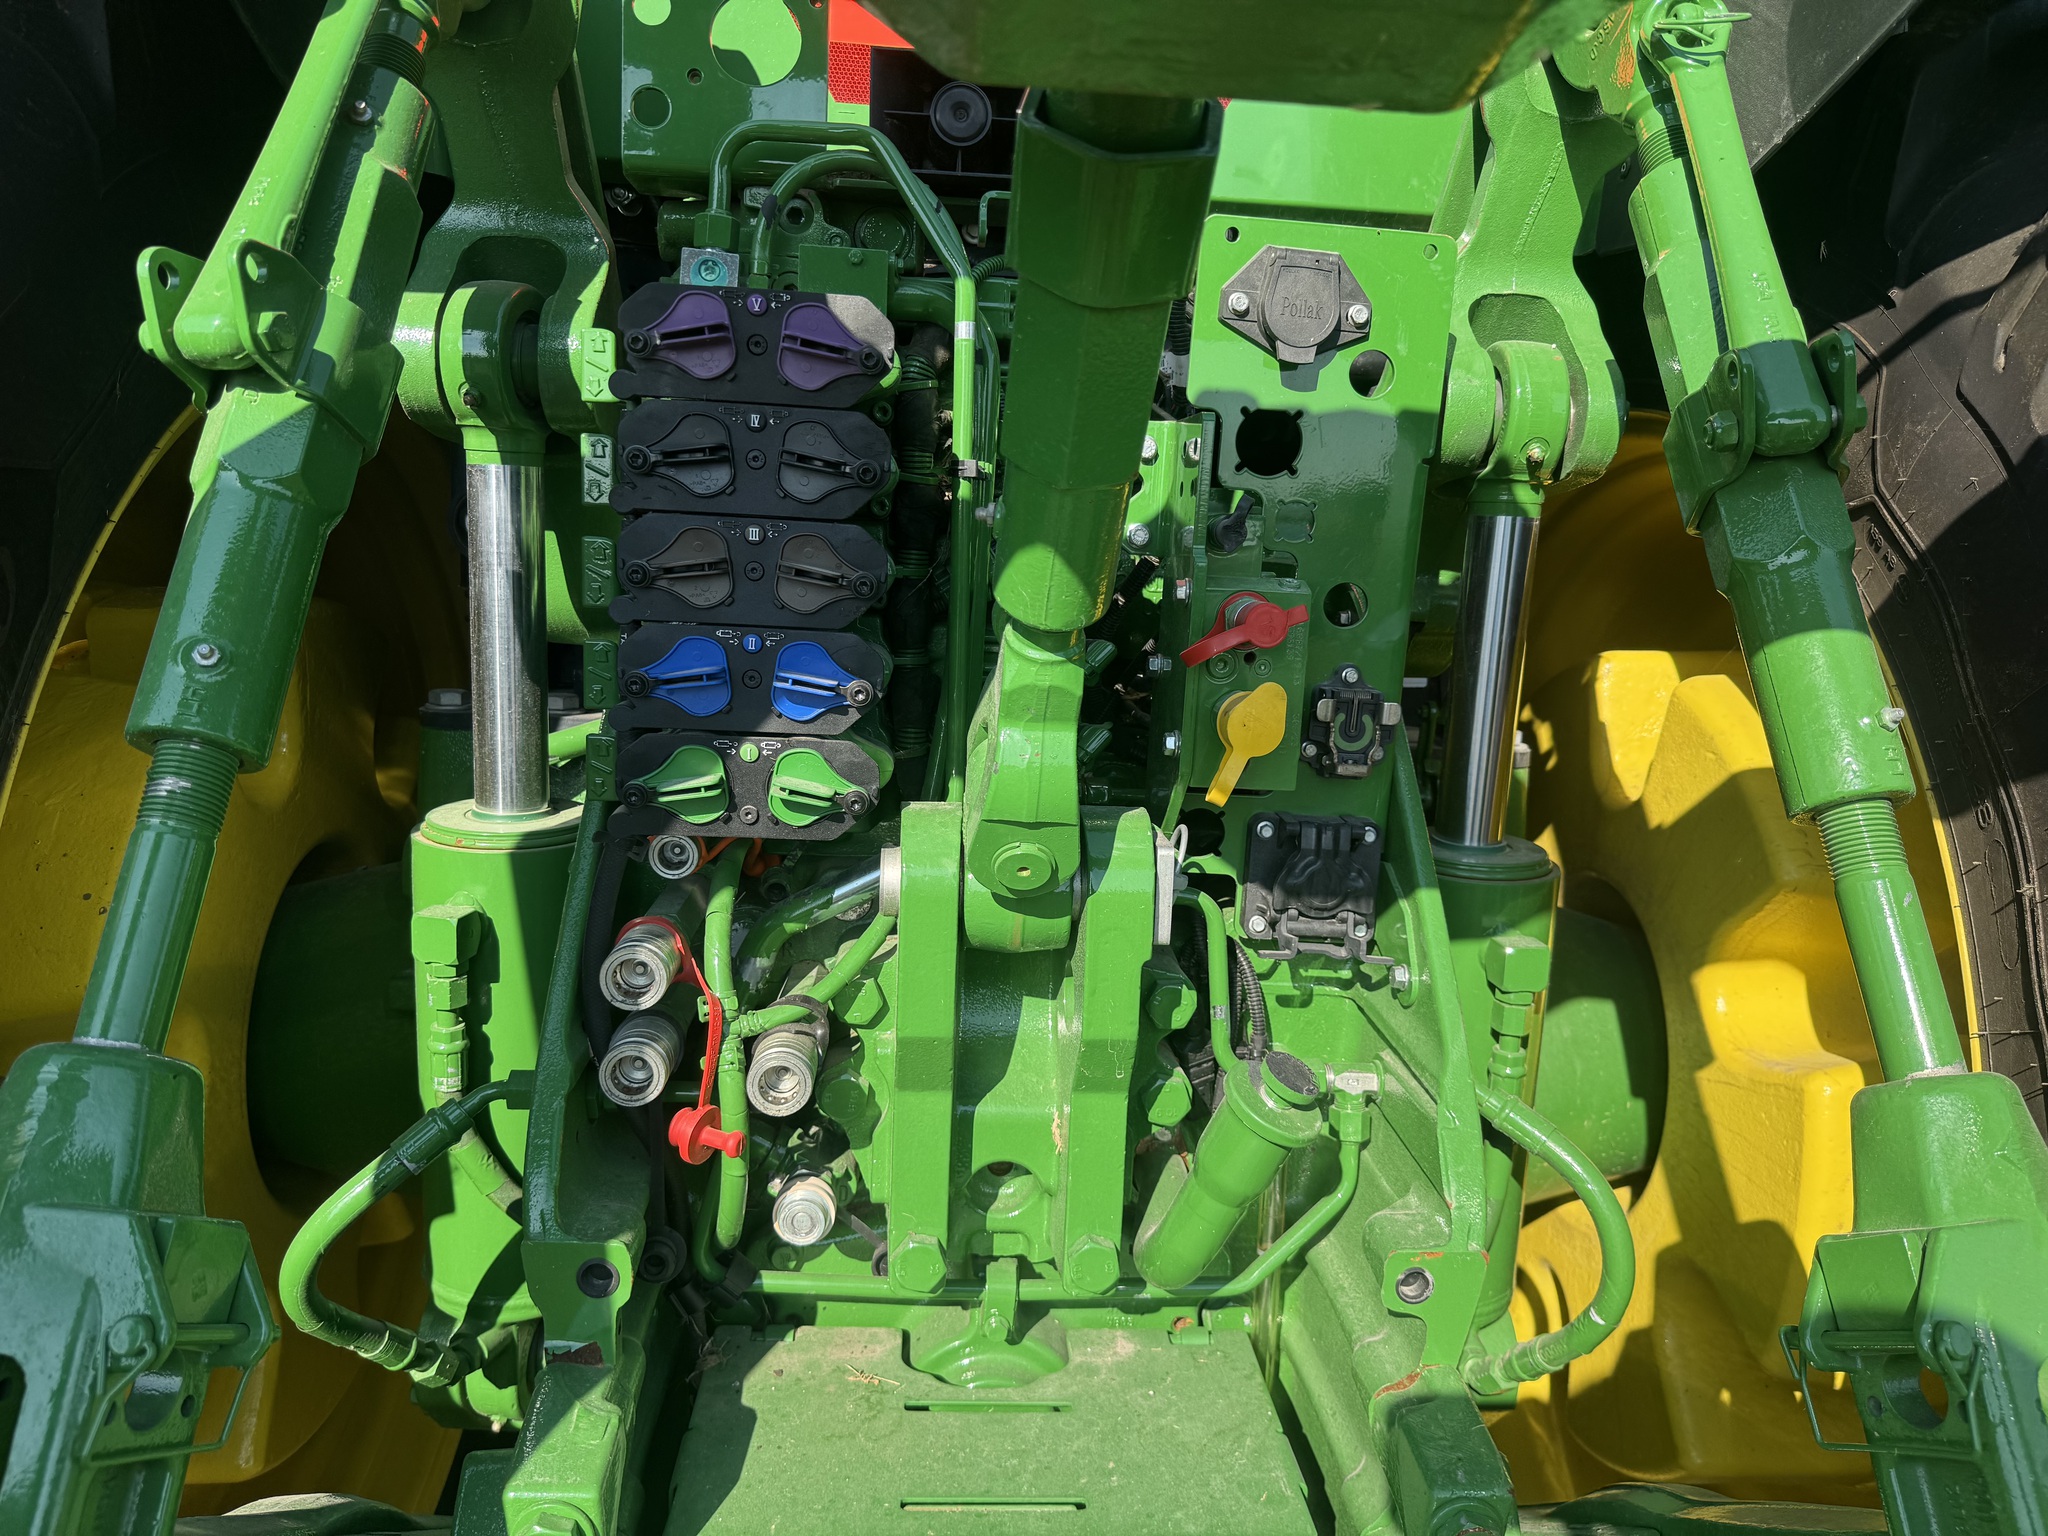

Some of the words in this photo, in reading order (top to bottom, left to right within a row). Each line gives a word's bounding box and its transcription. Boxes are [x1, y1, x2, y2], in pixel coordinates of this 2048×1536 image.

[751, 297, 762, 311] V
[1280, 296, 1323, 320] Pollak
[750, 414, 761, 428] IV
[749, 527, 760, 541] III
[748, 637, 756, 650] II
